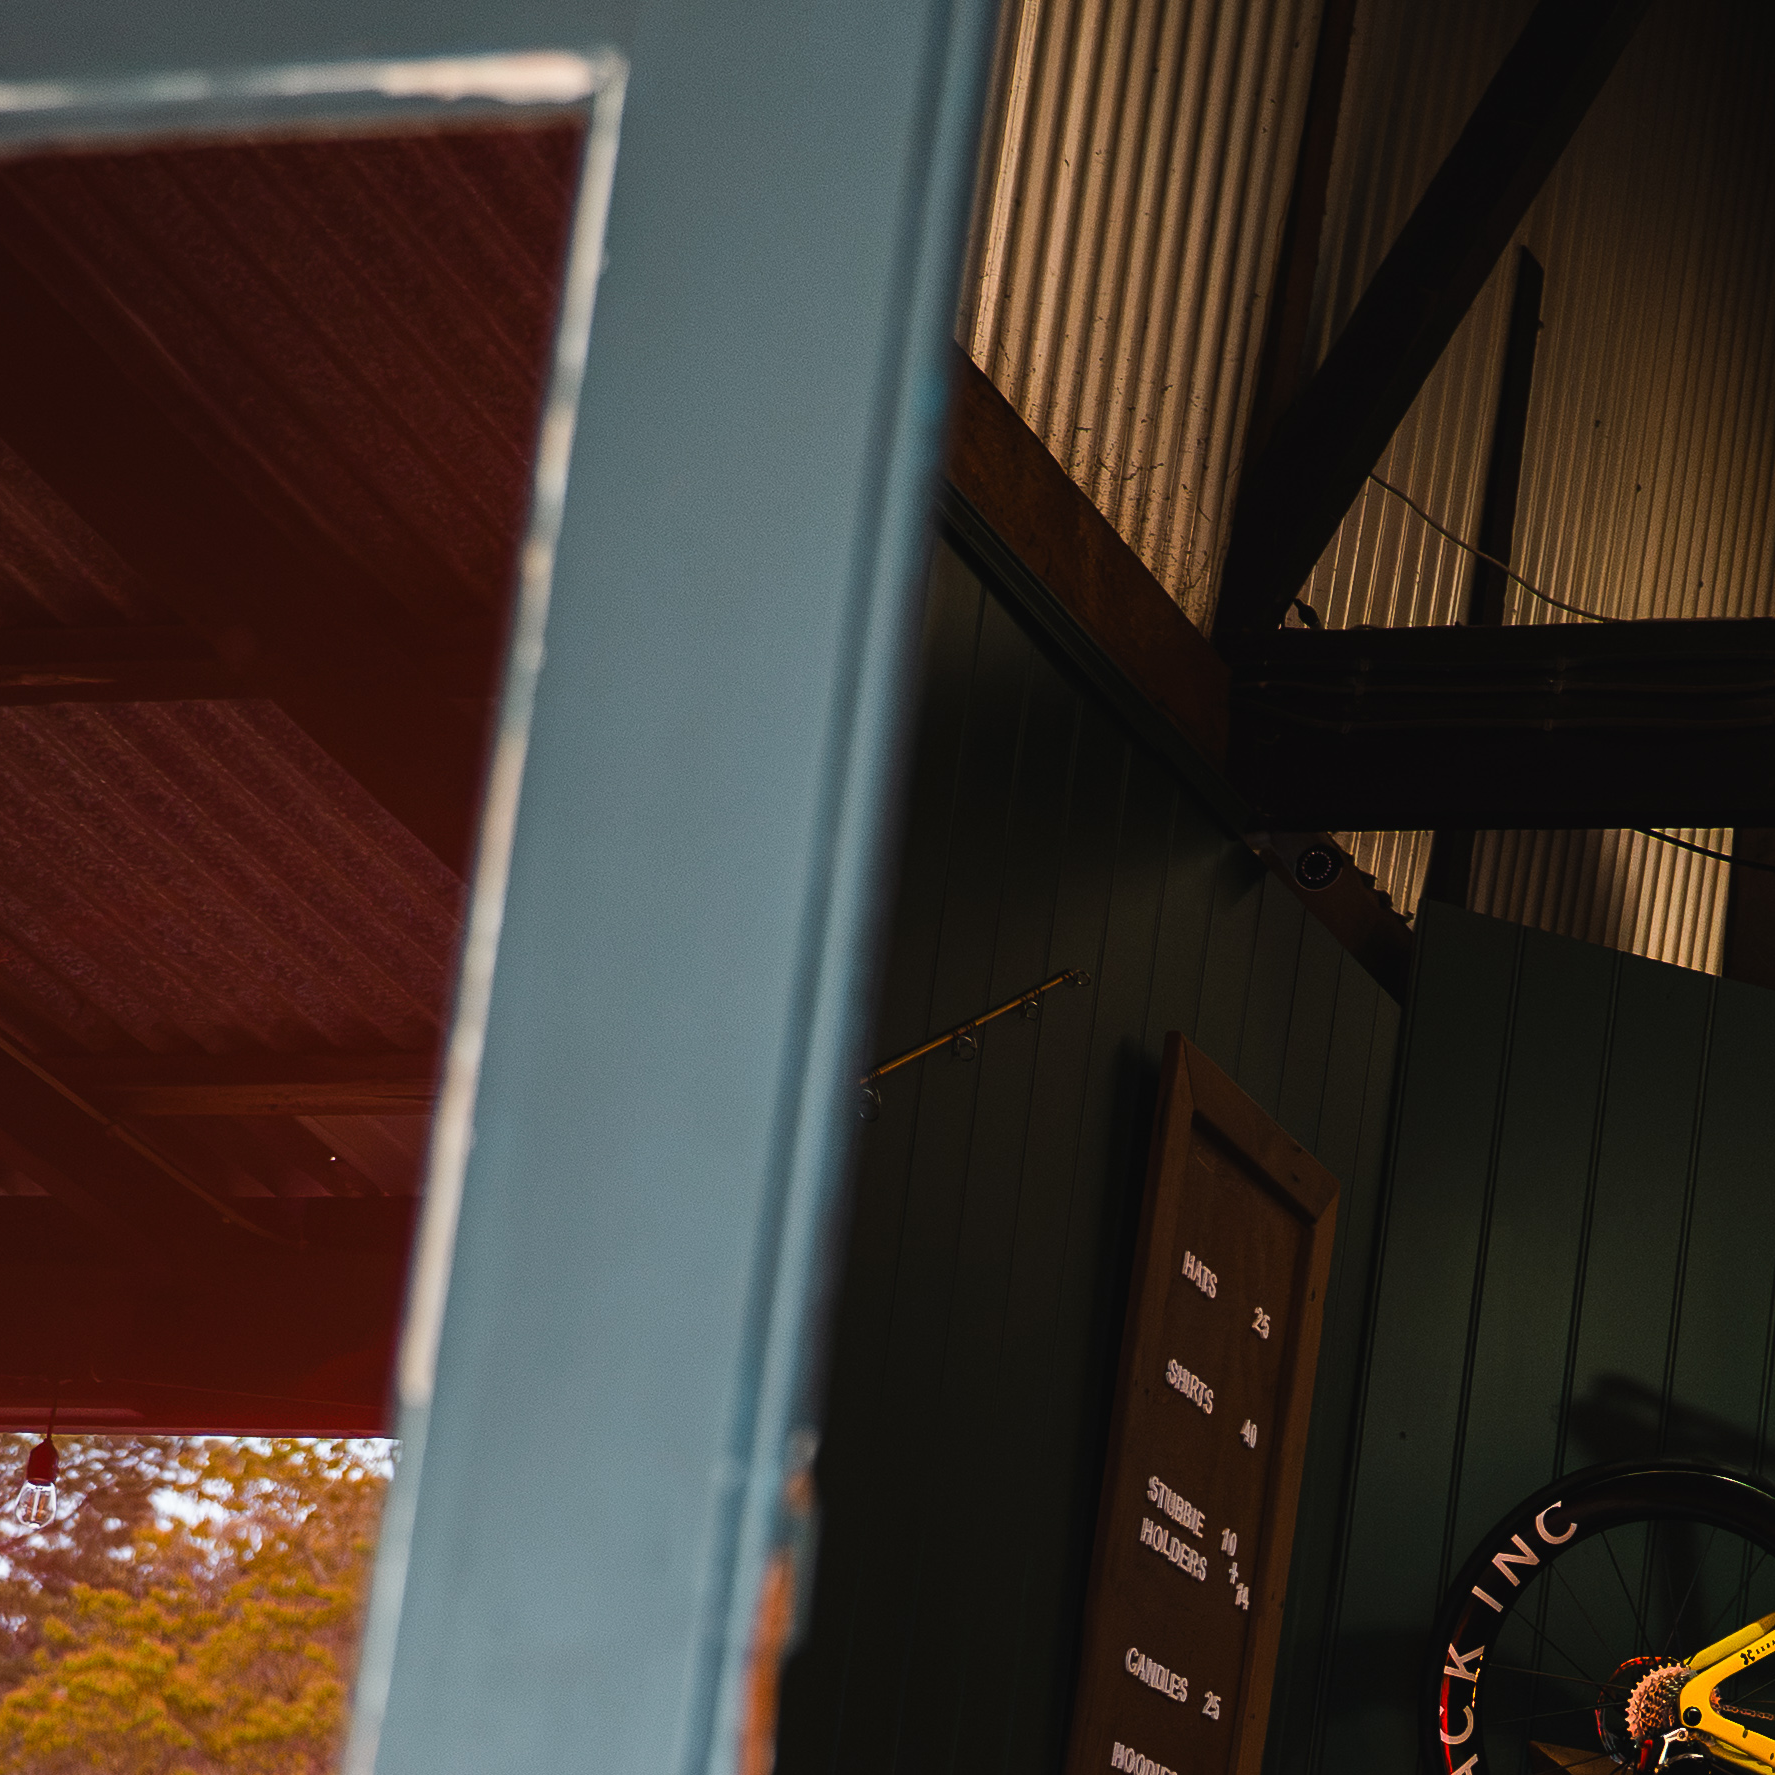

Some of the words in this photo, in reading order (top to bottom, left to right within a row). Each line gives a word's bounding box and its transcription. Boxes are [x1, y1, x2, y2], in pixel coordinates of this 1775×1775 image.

[1181, 1250, 1217, 1299] HATS
[1251, 1306, 1271, 1339] 25
[1165, 1359, 1214, 1415] SHIRTS
[1239, 1419, 1258, 1449] 40
[1140, 1517, 1207, 1581] HOLDERS
[1147, 1475, 1206, 1539] STUBBIE
[1221, 1528, 1237, 1556] 10
[1471, 1501, 1579, 1613] INC
[1125, 1647, 1188, 1703] CANDLES
[1201, 1690, 1221, 1720] 25
